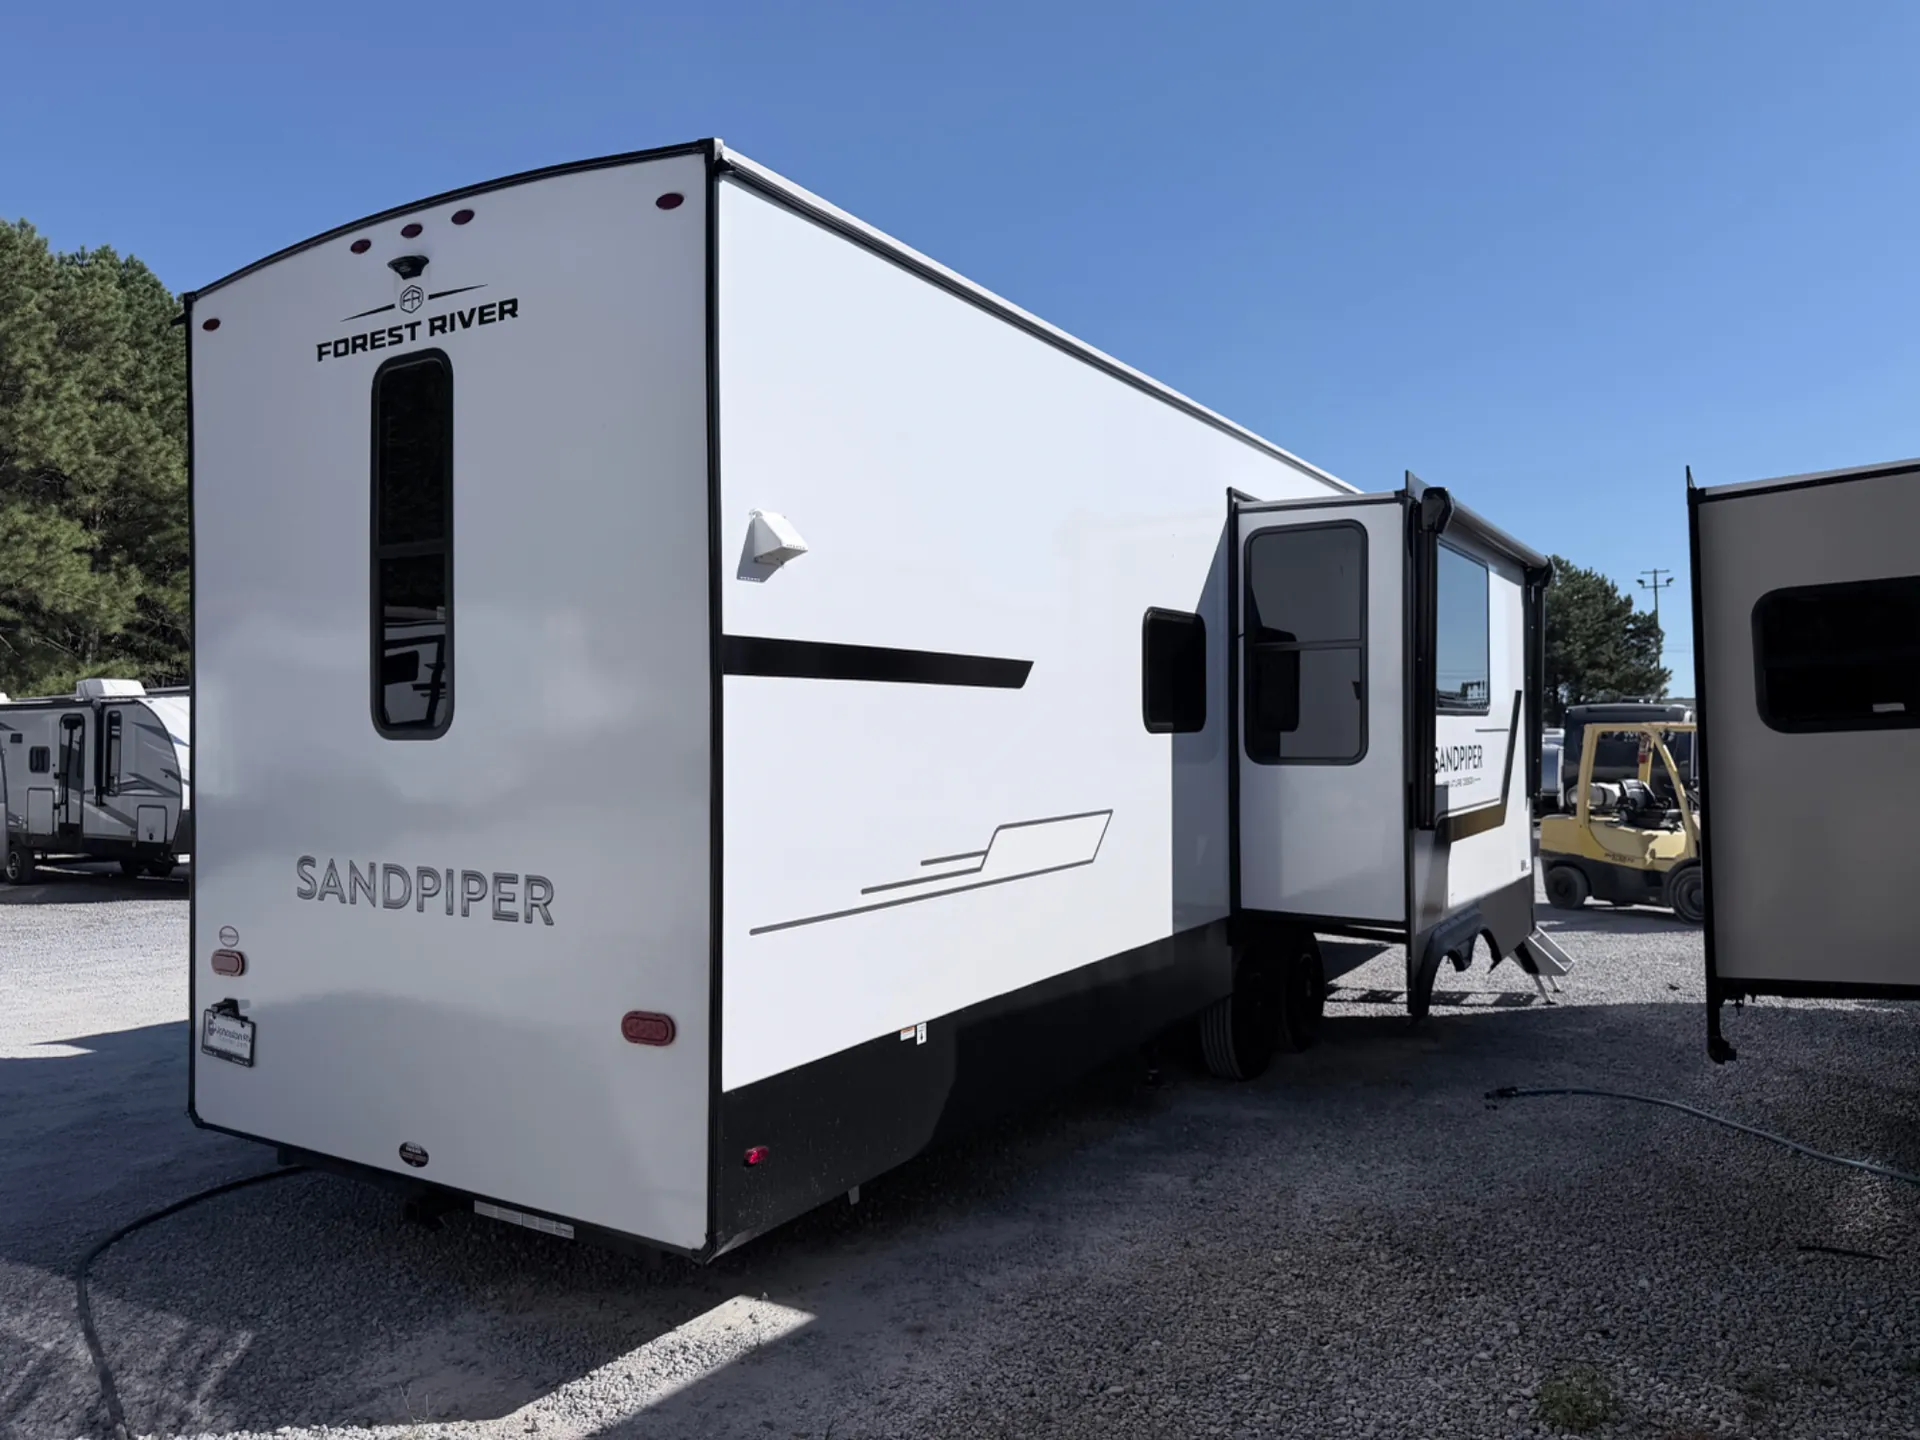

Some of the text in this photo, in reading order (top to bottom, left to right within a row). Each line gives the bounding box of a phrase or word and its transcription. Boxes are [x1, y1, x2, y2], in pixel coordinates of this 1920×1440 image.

[316, 298, 518, 362] FOREST RIVER
[296, 855, 555, 926] SANDPIPER
